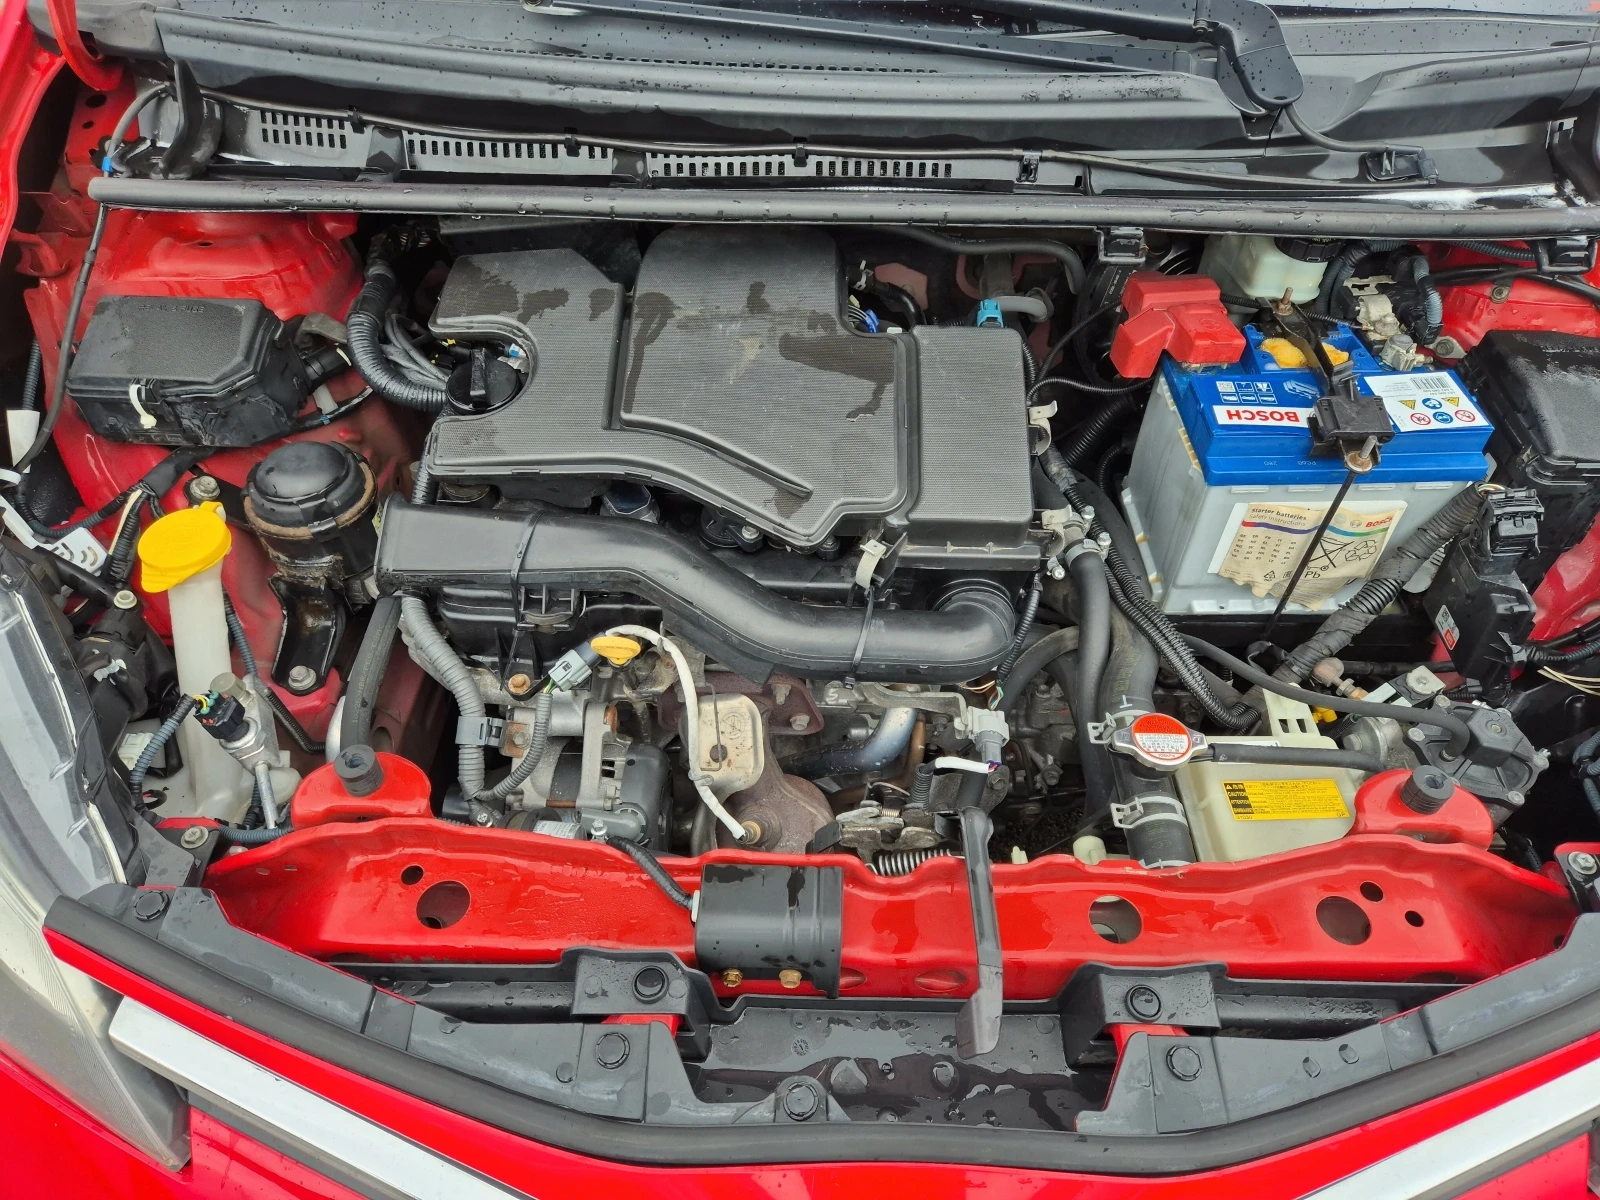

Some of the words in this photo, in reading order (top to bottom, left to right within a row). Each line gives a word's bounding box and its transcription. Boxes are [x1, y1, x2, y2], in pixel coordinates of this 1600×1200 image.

[1226, 409, 1300, 423] BOSCH
[1249, 513, 1269, 521] Safety
[1251, 507, 1275, 515] starter
[1276, 510, 1307, 521] batteries
